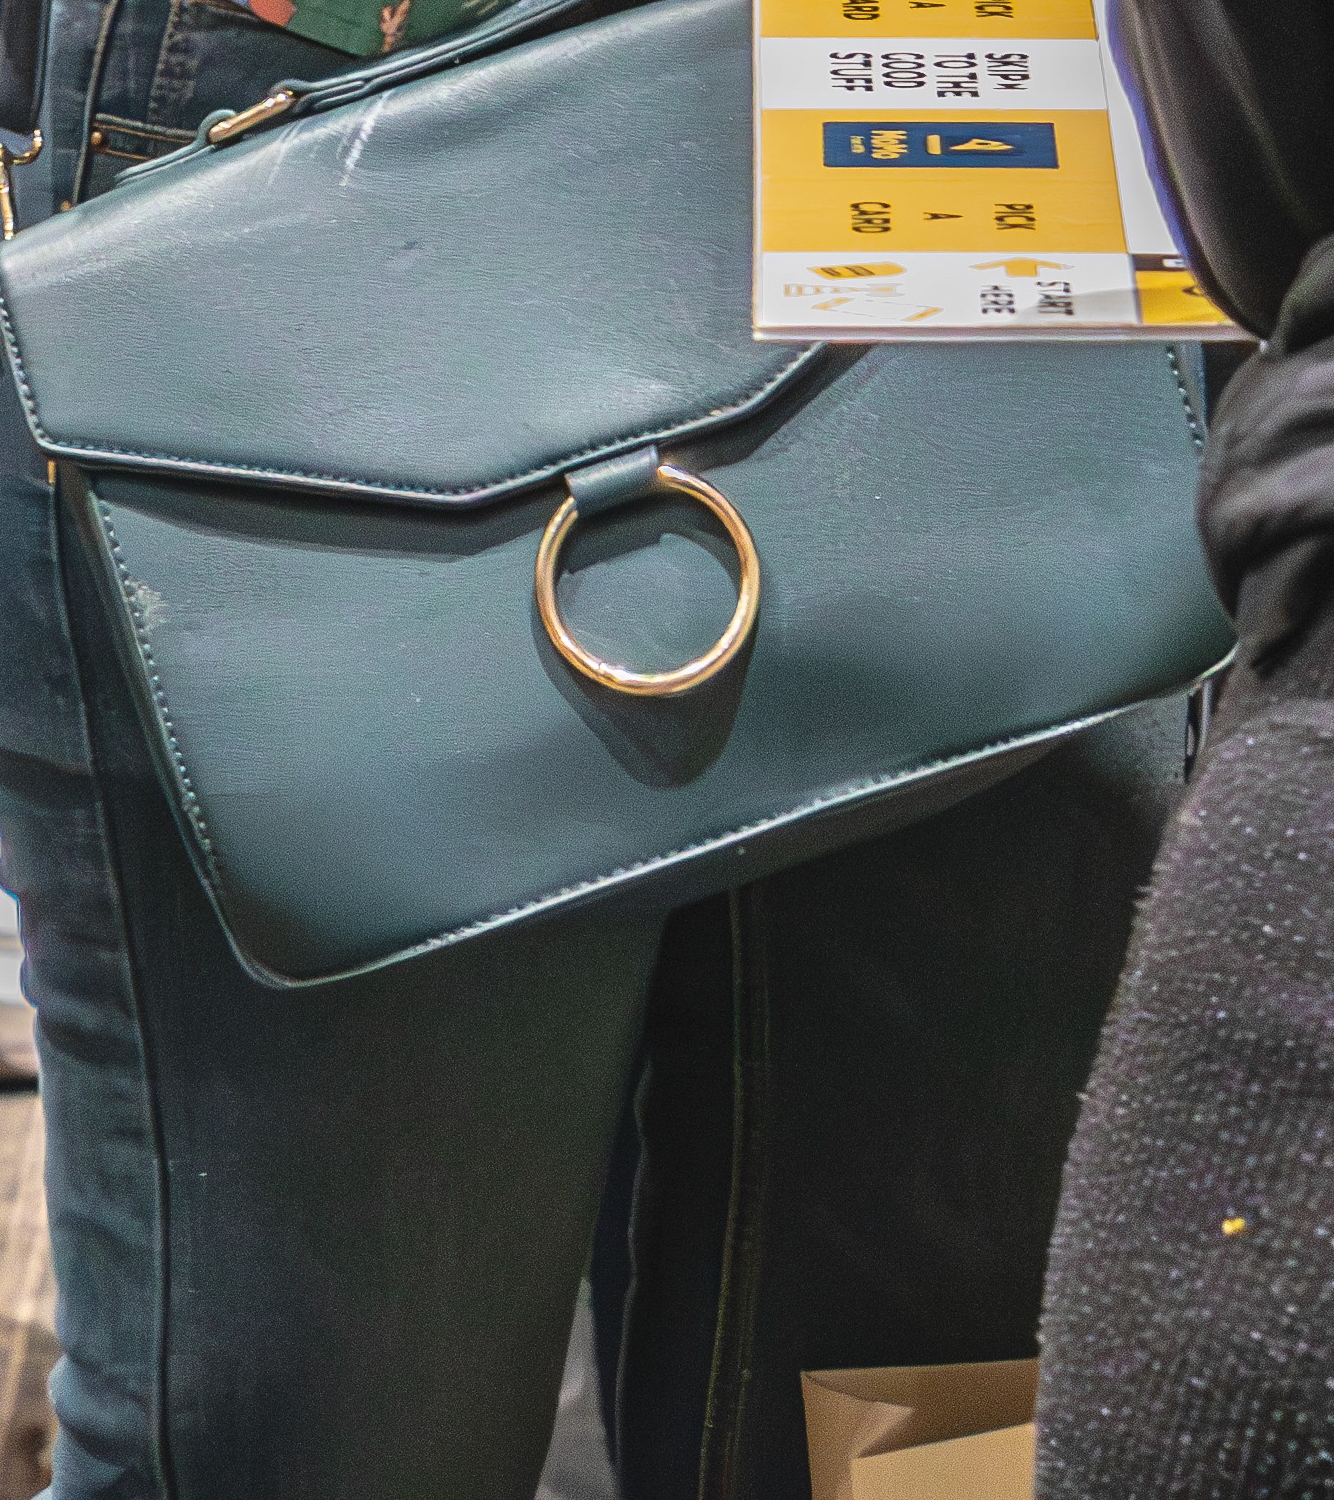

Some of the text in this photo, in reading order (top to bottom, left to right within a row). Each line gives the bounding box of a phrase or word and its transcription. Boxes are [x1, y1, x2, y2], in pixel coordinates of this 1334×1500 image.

[908, 1, 946, 9] A
[828, 52, 874, 92] STUFF
[880, 52, 927, 89] GOOD
[933, 52, 980, 98] TO THE
[985, 52, 1031, 81] SKIP
[870, 129, 908, 160] MoMo
[850, 201, 892, 234] CARD
[923, 211, 964, 221] A
[994, 203, 1036, 231] PICK
[980, 285, 1017, 315] HERE
[1036, 281, 1075, 316] START
